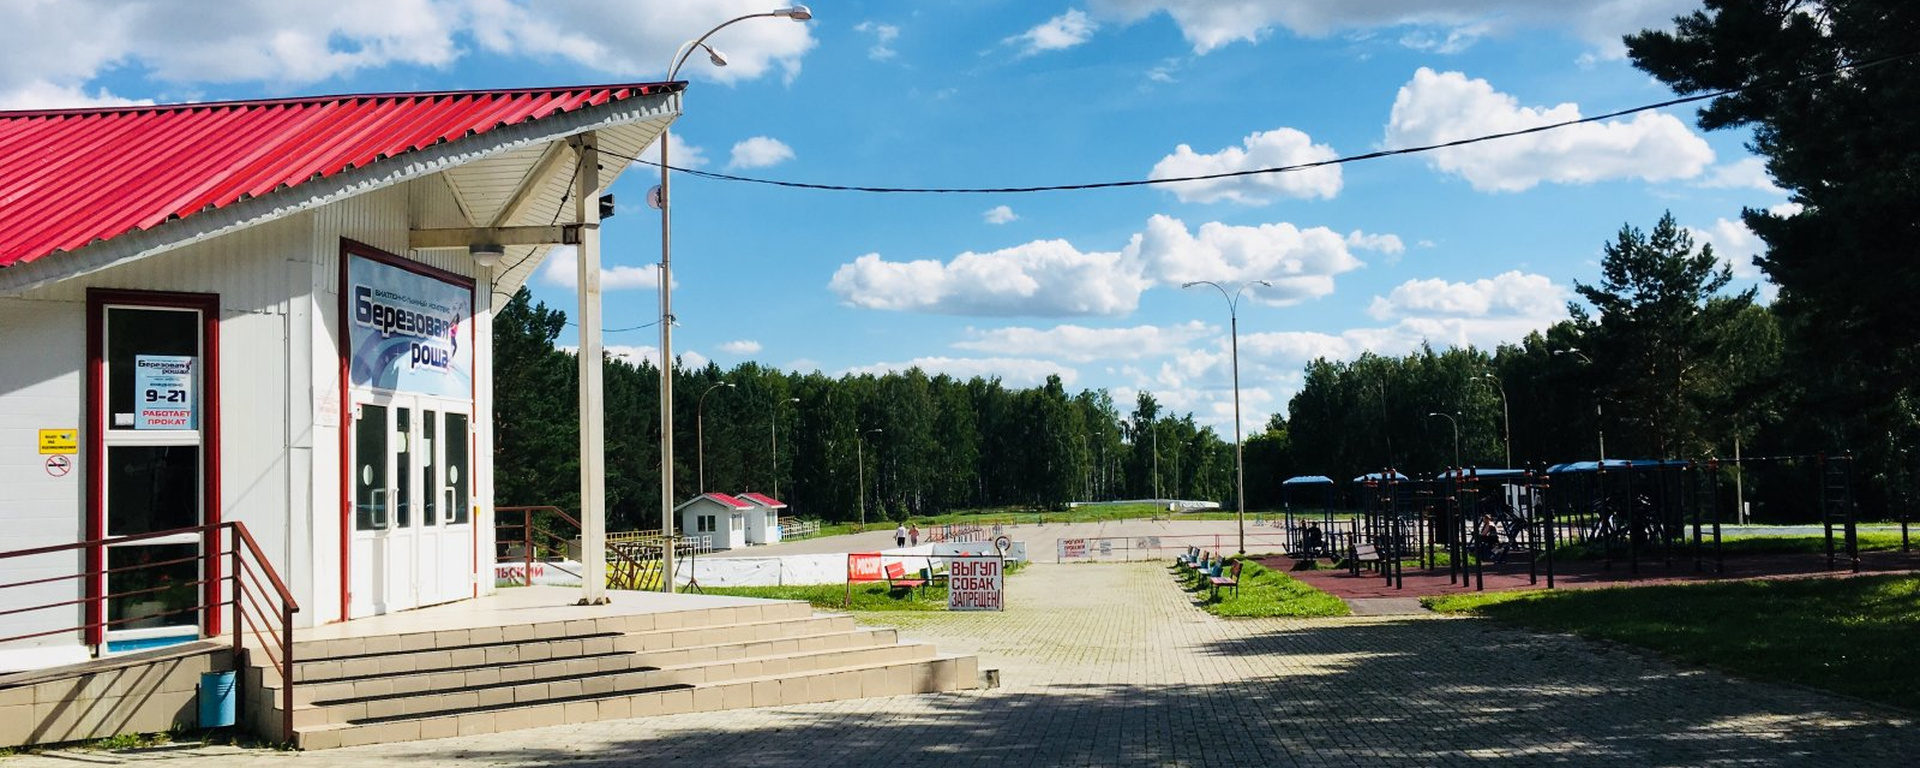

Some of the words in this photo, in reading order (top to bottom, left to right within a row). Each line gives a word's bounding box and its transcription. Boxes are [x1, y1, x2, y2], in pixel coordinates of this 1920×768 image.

[355, 285, 449, 340] Березовая
[138, 359, 185, 369] Березовая
[146, 389, 186, 403] 9-21
[951, 561, 997, 576] ВЫГУЛ
[951, 577, 995, 591] СОБАК
[951, 589, 1000, 609] ЗАПРЕЩЕН!
